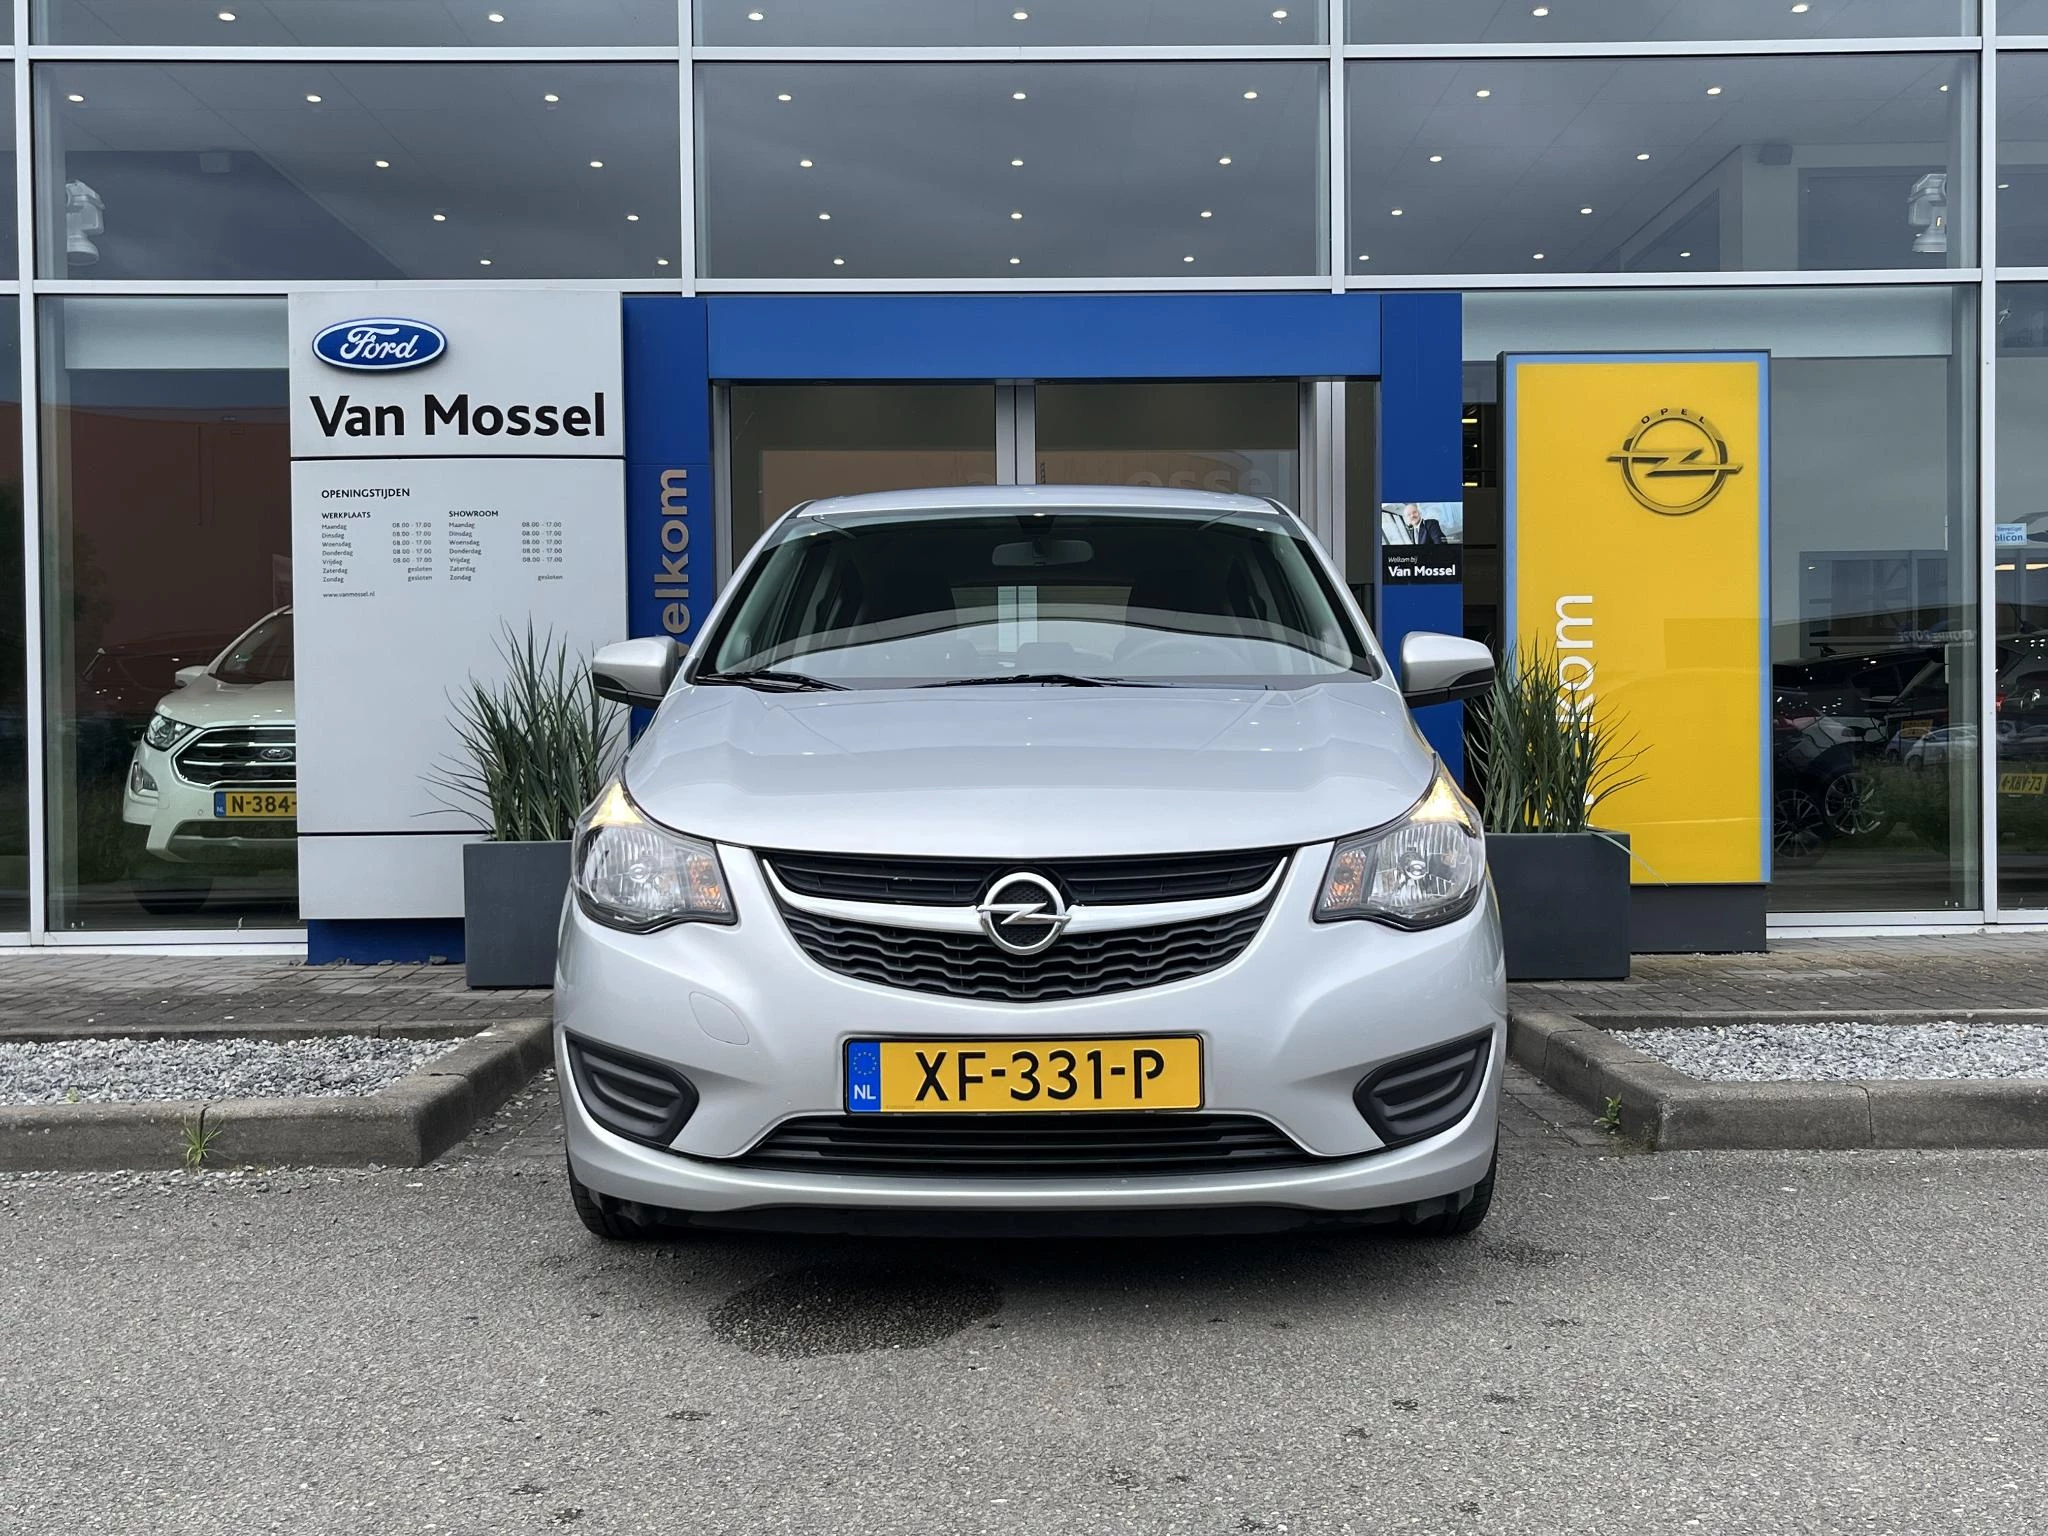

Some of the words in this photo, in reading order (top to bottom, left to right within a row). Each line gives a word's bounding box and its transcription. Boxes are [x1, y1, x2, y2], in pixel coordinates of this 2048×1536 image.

[340, 327, 419, 360] Ford
[310, 395, 405, 437] Van
[424, 392, 605, 436] Mossel
[1641, 408, 1705, 424] OPEL
[321, 488, 410, 499] OPENINGSTIJDEN
[321, 511, 371, 519] WERKPLAATS
[654, 469, 690, 657] elkom
[1388, 566, 1411, 577] Van
[1414, 564, 1456, 576] Mossel
[853, 1084, 876, 1100] NL
[914, 1049, 1165, 1101] XF-331-P
